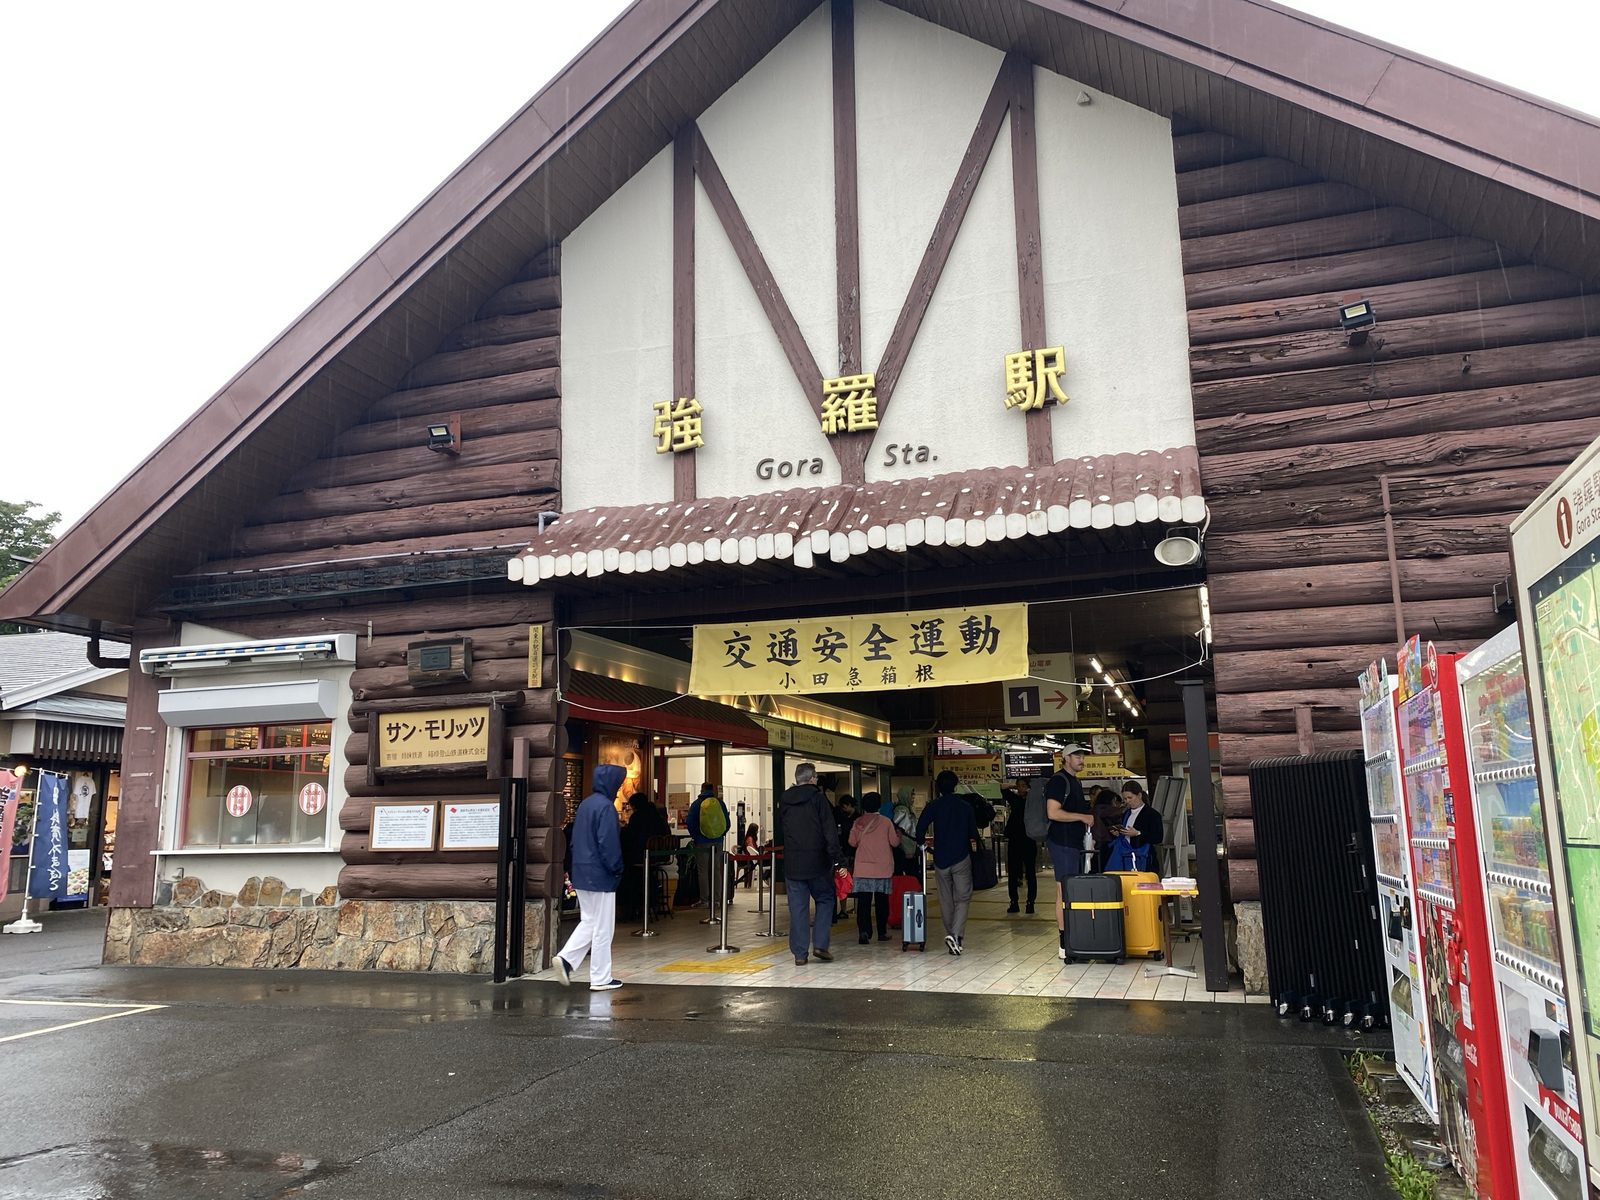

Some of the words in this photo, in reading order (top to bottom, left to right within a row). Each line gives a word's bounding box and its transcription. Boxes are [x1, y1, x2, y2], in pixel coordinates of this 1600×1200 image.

[755, 456, 824, 481] Gora
[883, 442, 939, 468] Sta.
[1576, 514, 1591, 535] Gora
[722, 613, 1001, 670] 交通安全運動
[779, 663, 936, 690] 小田急箱根
[1017, 691, 1029, 712] 1
[386, 716, 486, 744] サン・モリッツ
